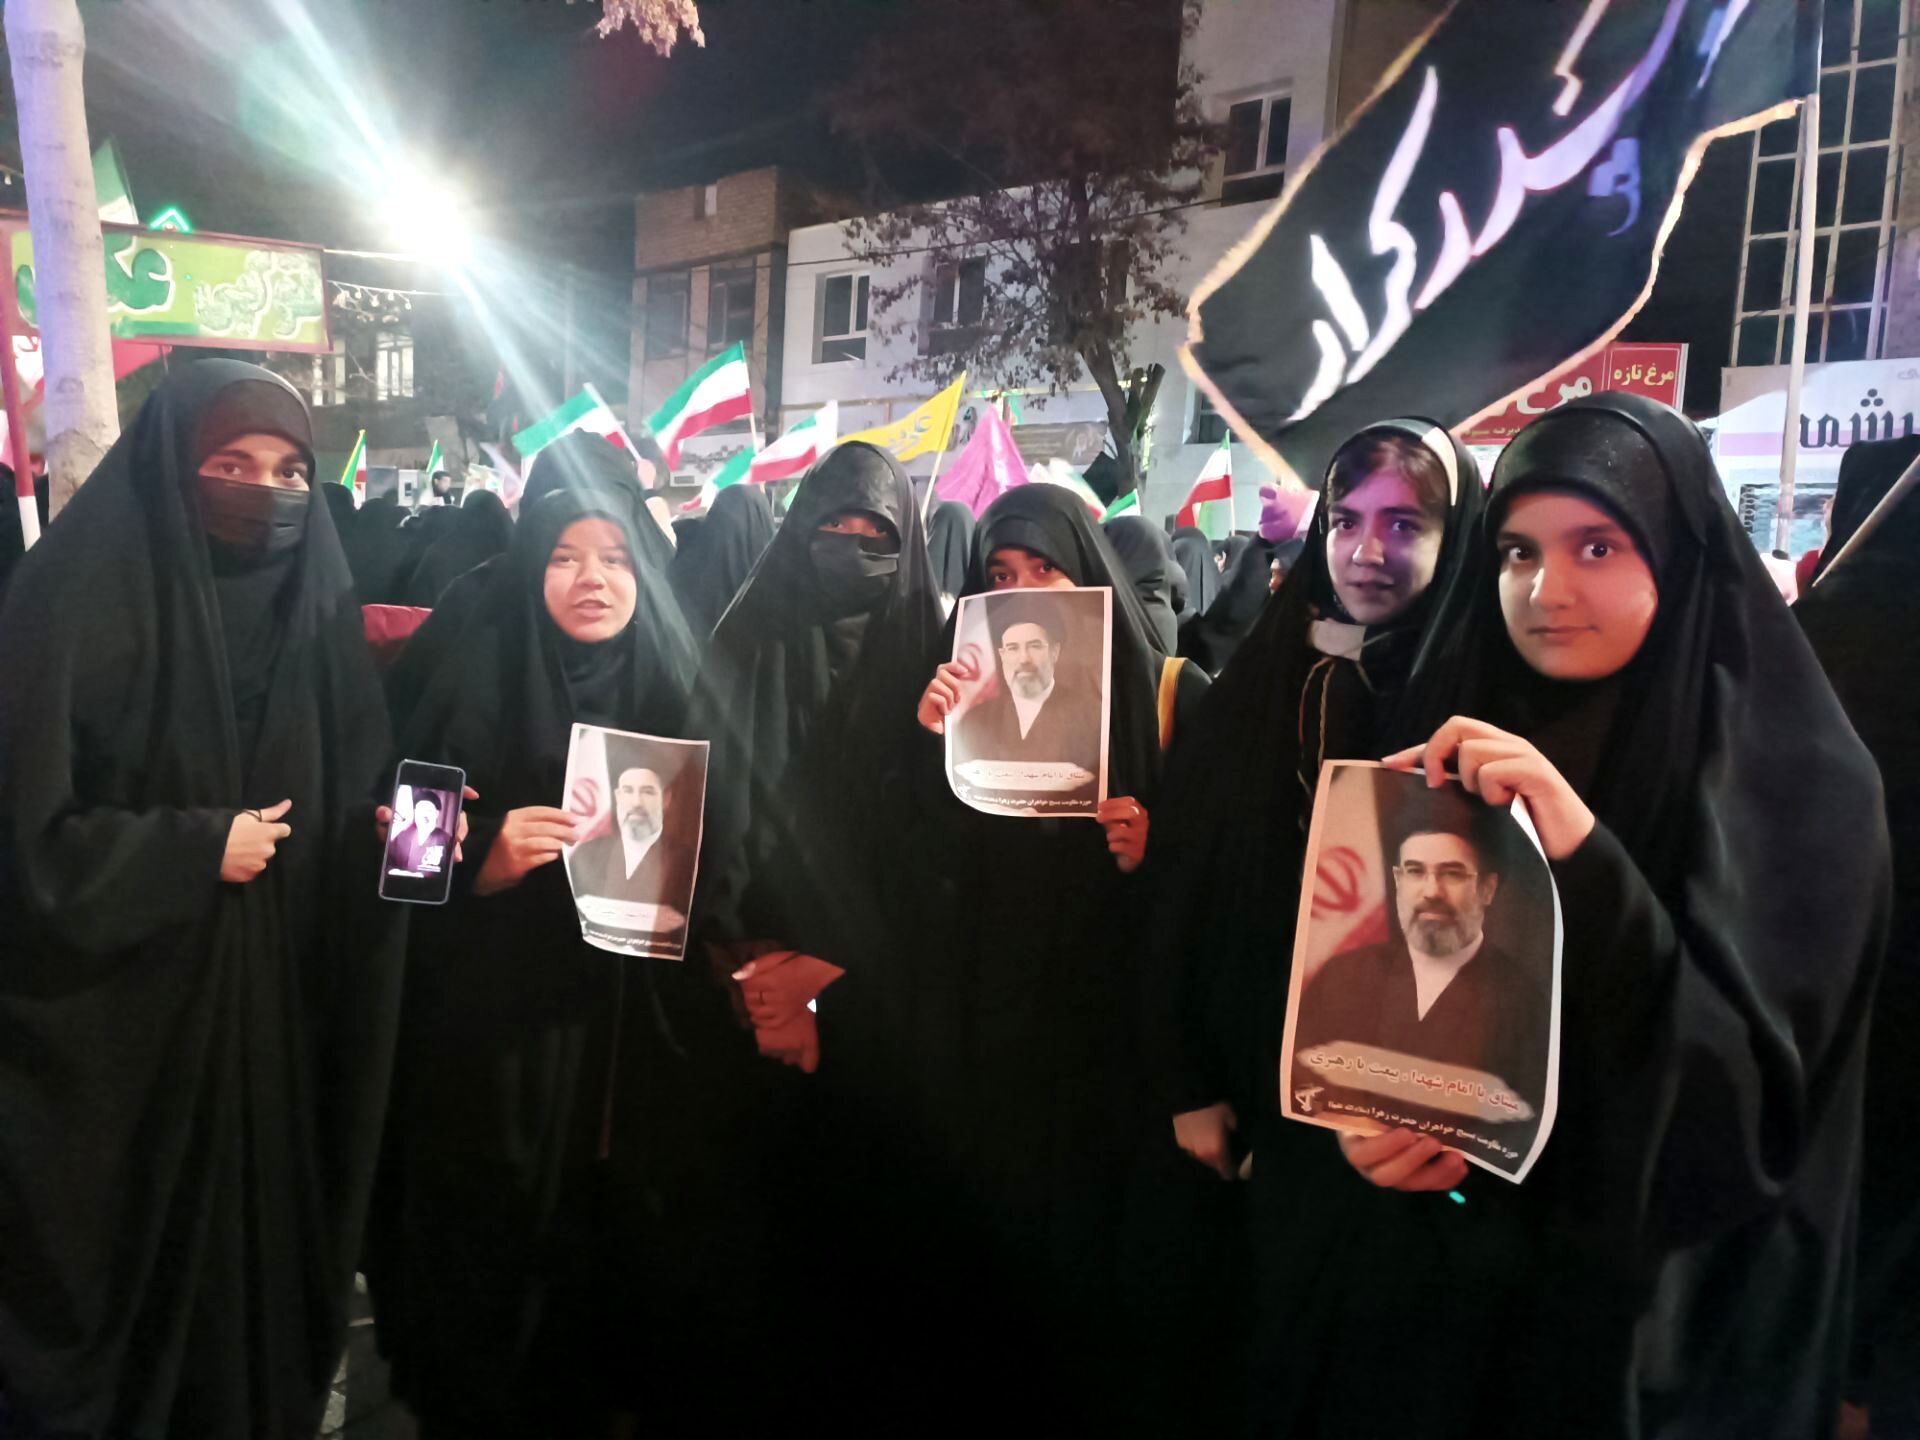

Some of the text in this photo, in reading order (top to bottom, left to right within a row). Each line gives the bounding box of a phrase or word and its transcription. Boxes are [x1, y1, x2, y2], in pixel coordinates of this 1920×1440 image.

[1285, 64, 1439, 425] کرار
[1613, 362, 1675, 386] مرغ تازه
[1447, 1081, 1473, 1095] امام
[1419, 1121, 1455, 1135] خواهران
